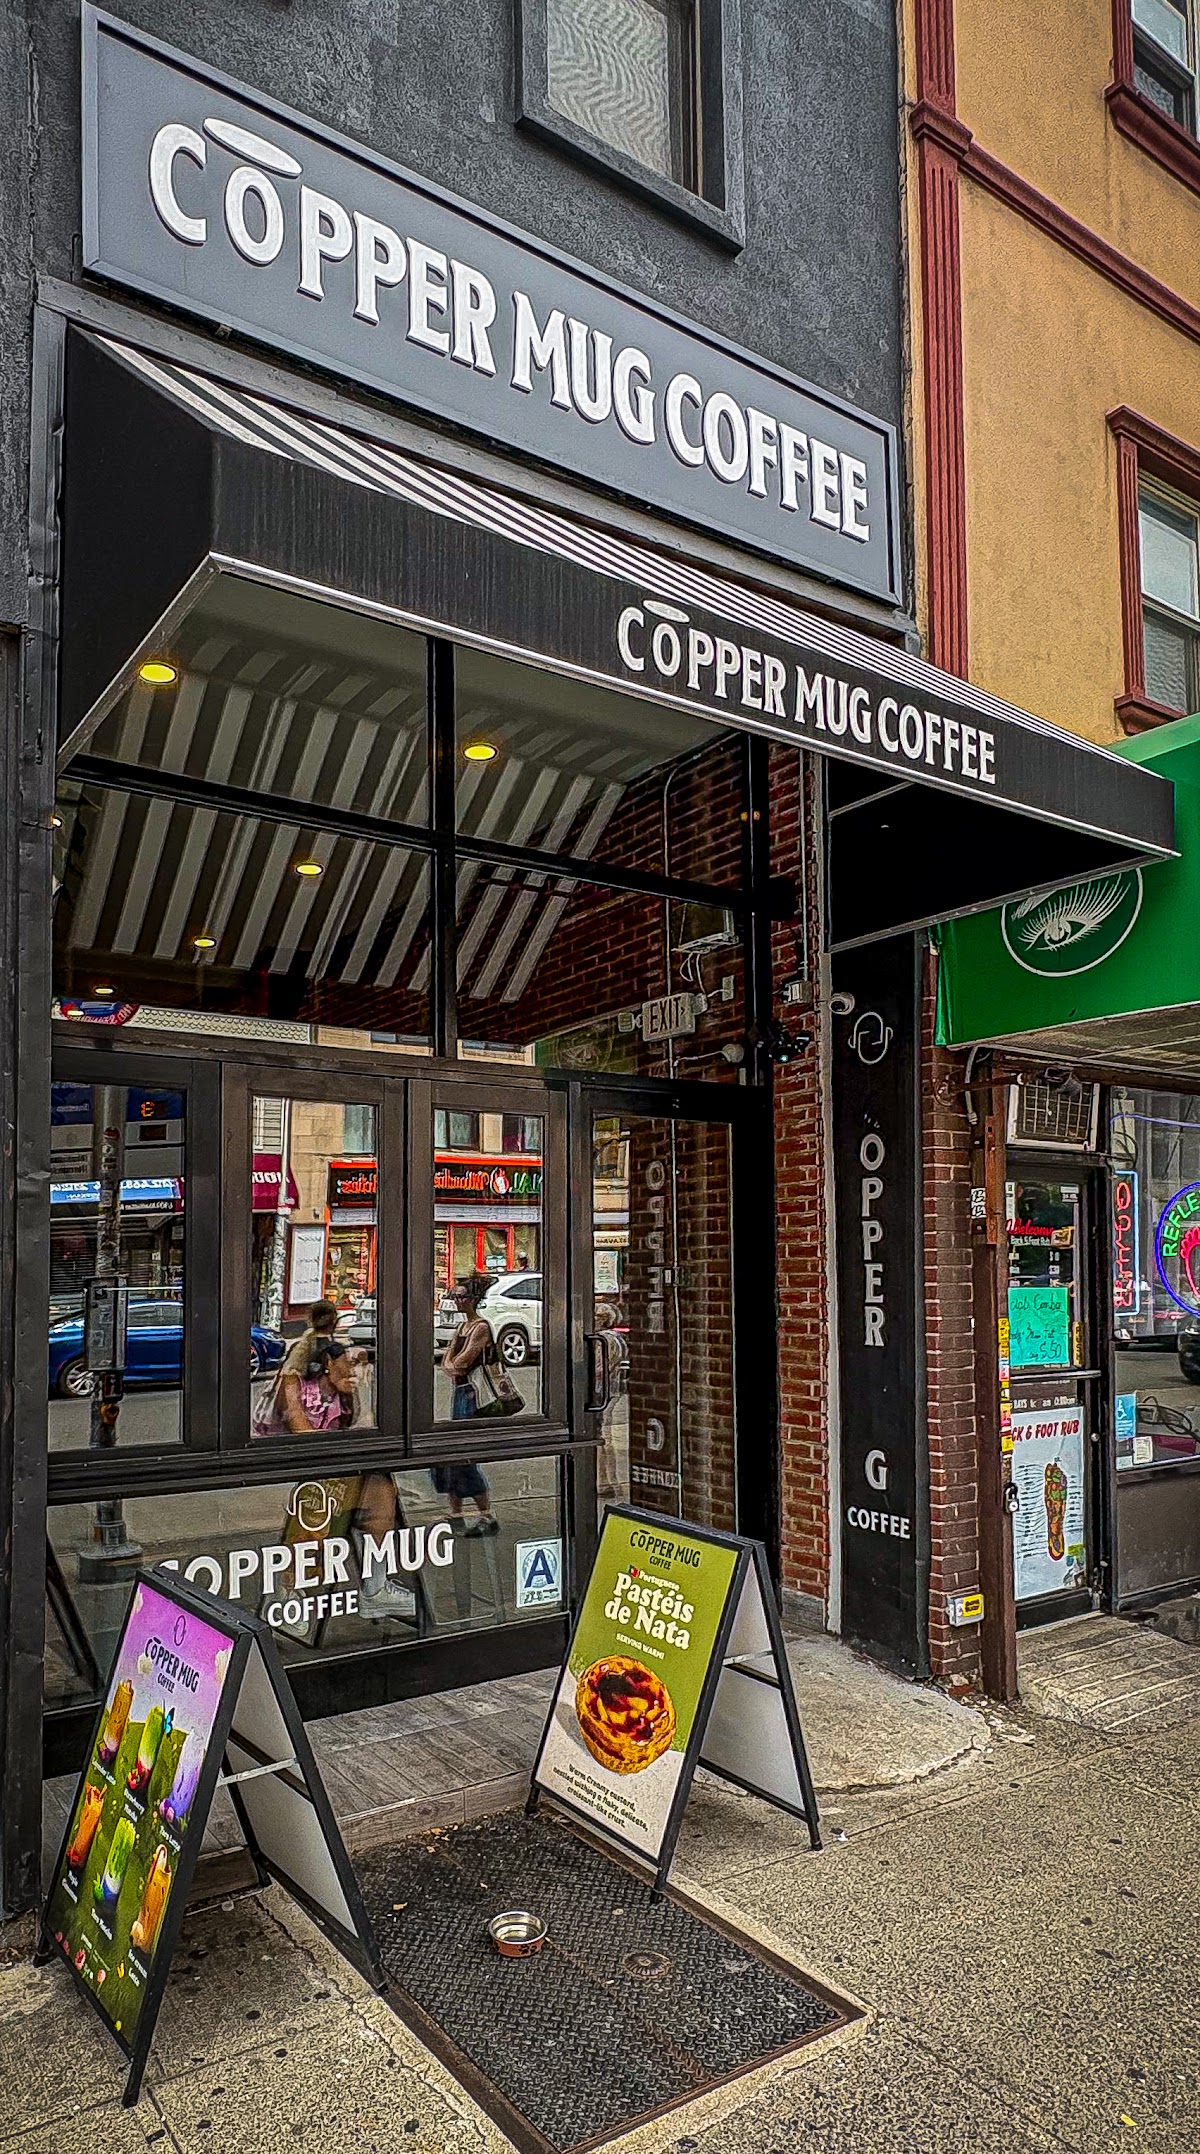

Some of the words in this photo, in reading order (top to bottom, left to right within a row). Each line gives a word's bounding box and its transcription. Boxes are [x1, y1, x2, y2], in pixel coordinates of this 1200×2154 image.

[148, 118, 498, 376] COPPER
[511, 292, 655, 444] MUG
[665, 373, 871, 542] COFFEE
[616, 600, 787, 717] COPPER
[794, 666, 872, 743] MUG
[877, 704, 997, 785] COFFEE
[650, 996, 681, 1034] EXIT
[1163, 1190, 1200, 1257] REFLE
[1012, 1426, 1024, 1442] CK
[1035, 1421, 1059, 1438] FOOT
[1060, 1419, 1080, 1436] RUB
[847, 1506, 911, 1539] COFFEE
[159, 1537, 350, 1600] OPPER
[361, 1523, 454, 1579] MUG
[524, 1549, 554, 1588] A
[630, 1529, 674, 1559] COPPER
[674, 1545, 701, 1568] MUG
[649, 1555, 671, 1570] COFFEE
[613, 1572, 694, 1623] Pastéis
[639, 1570, 680, 1591] Portuguese
[267, 1590, 359, 1627] COFFEE
[604, 1596, 631, 1624] de
[633, 1605, 690, 1650] Nata
[616, 1633, 642, 1650] SERVING
[144, 1636, 180, 1679] COPPER
[177, 1661, 200, 1693] MUG
[157, 1673, 175, 1694] COFFEE
[553, 1766, 574, 1784] nestled
[602, 1797, 619, 1814] flaky,
[620, 1808, 648, 1832] delicate,
[567, 1786, 608, 1816] croissant-like
[608, 1811, 626, 1828] crust.
[569, 1763, 586, 1780] Warm
[586, 1775, 609, 1795] Creamy
[609, 1791, 636, 1812] custard,
